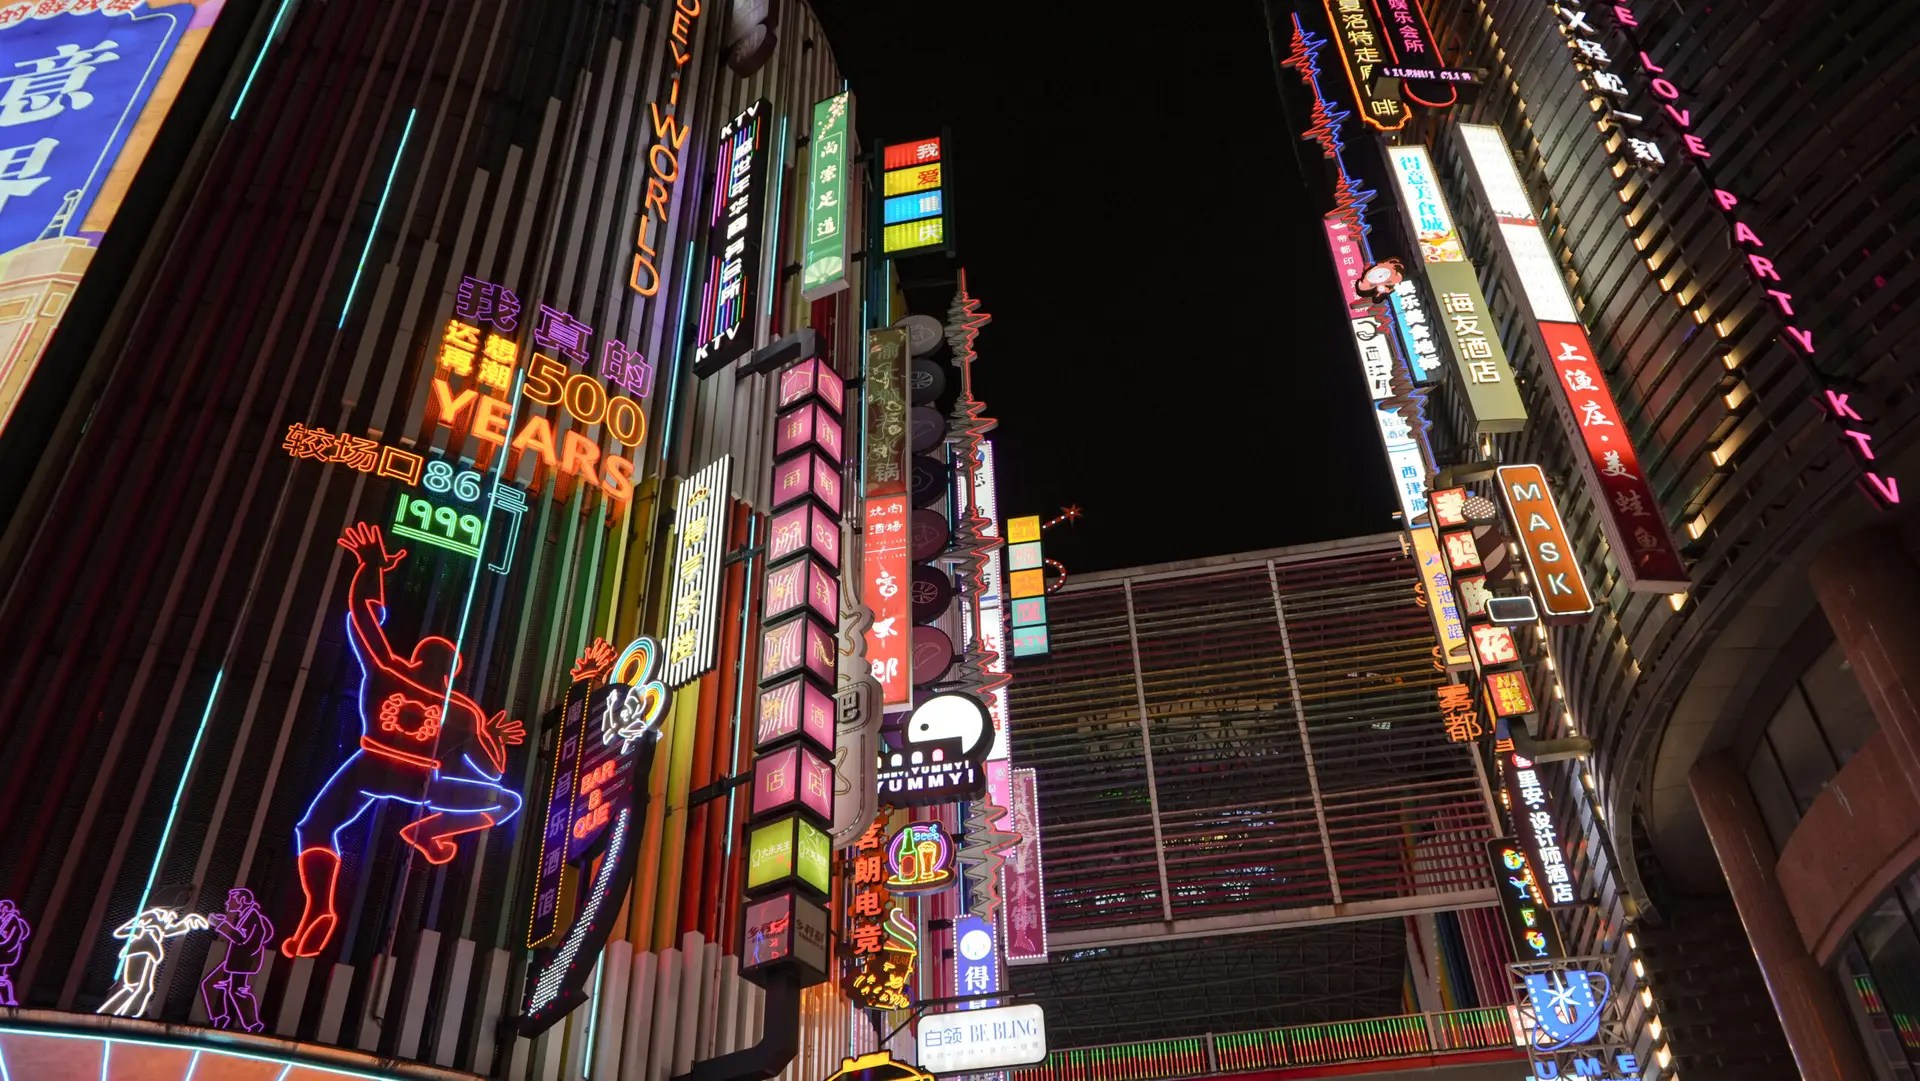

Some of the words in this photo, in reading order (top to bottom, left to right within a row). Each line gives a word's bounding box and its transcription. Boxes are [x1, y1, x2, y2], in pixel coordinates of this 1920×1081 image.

[720, 101, 759, 140] KTV
[630, 102, 690, 296] WORLD
[916, 142, 942, 242] 我爱重庆
[1639, 51, 1712, 159] LOVE
[1713, 188, 1815, 354] PARTY
[1825, 389, 1900, 504] KTV
[694, 321, 741, 364] KTV
[1443, 291, 1501, 384] 海友酒店
[522, 352, 645, 448] 500
[431, 377, 636, 502] YEARS
[394, 493, 487, 547] 1999
[1511, 484, 1572, 595] MASK
[579, 758, 618, 797] BAR
[572, 808, 612, 842] QUE
[924, 1025, 963, 1048] 白领
[969, 1025, 990, 1044] BE
[992, 1017, 1038, 1043] BLING
[1534, 1054, 1640, 1080] UME
